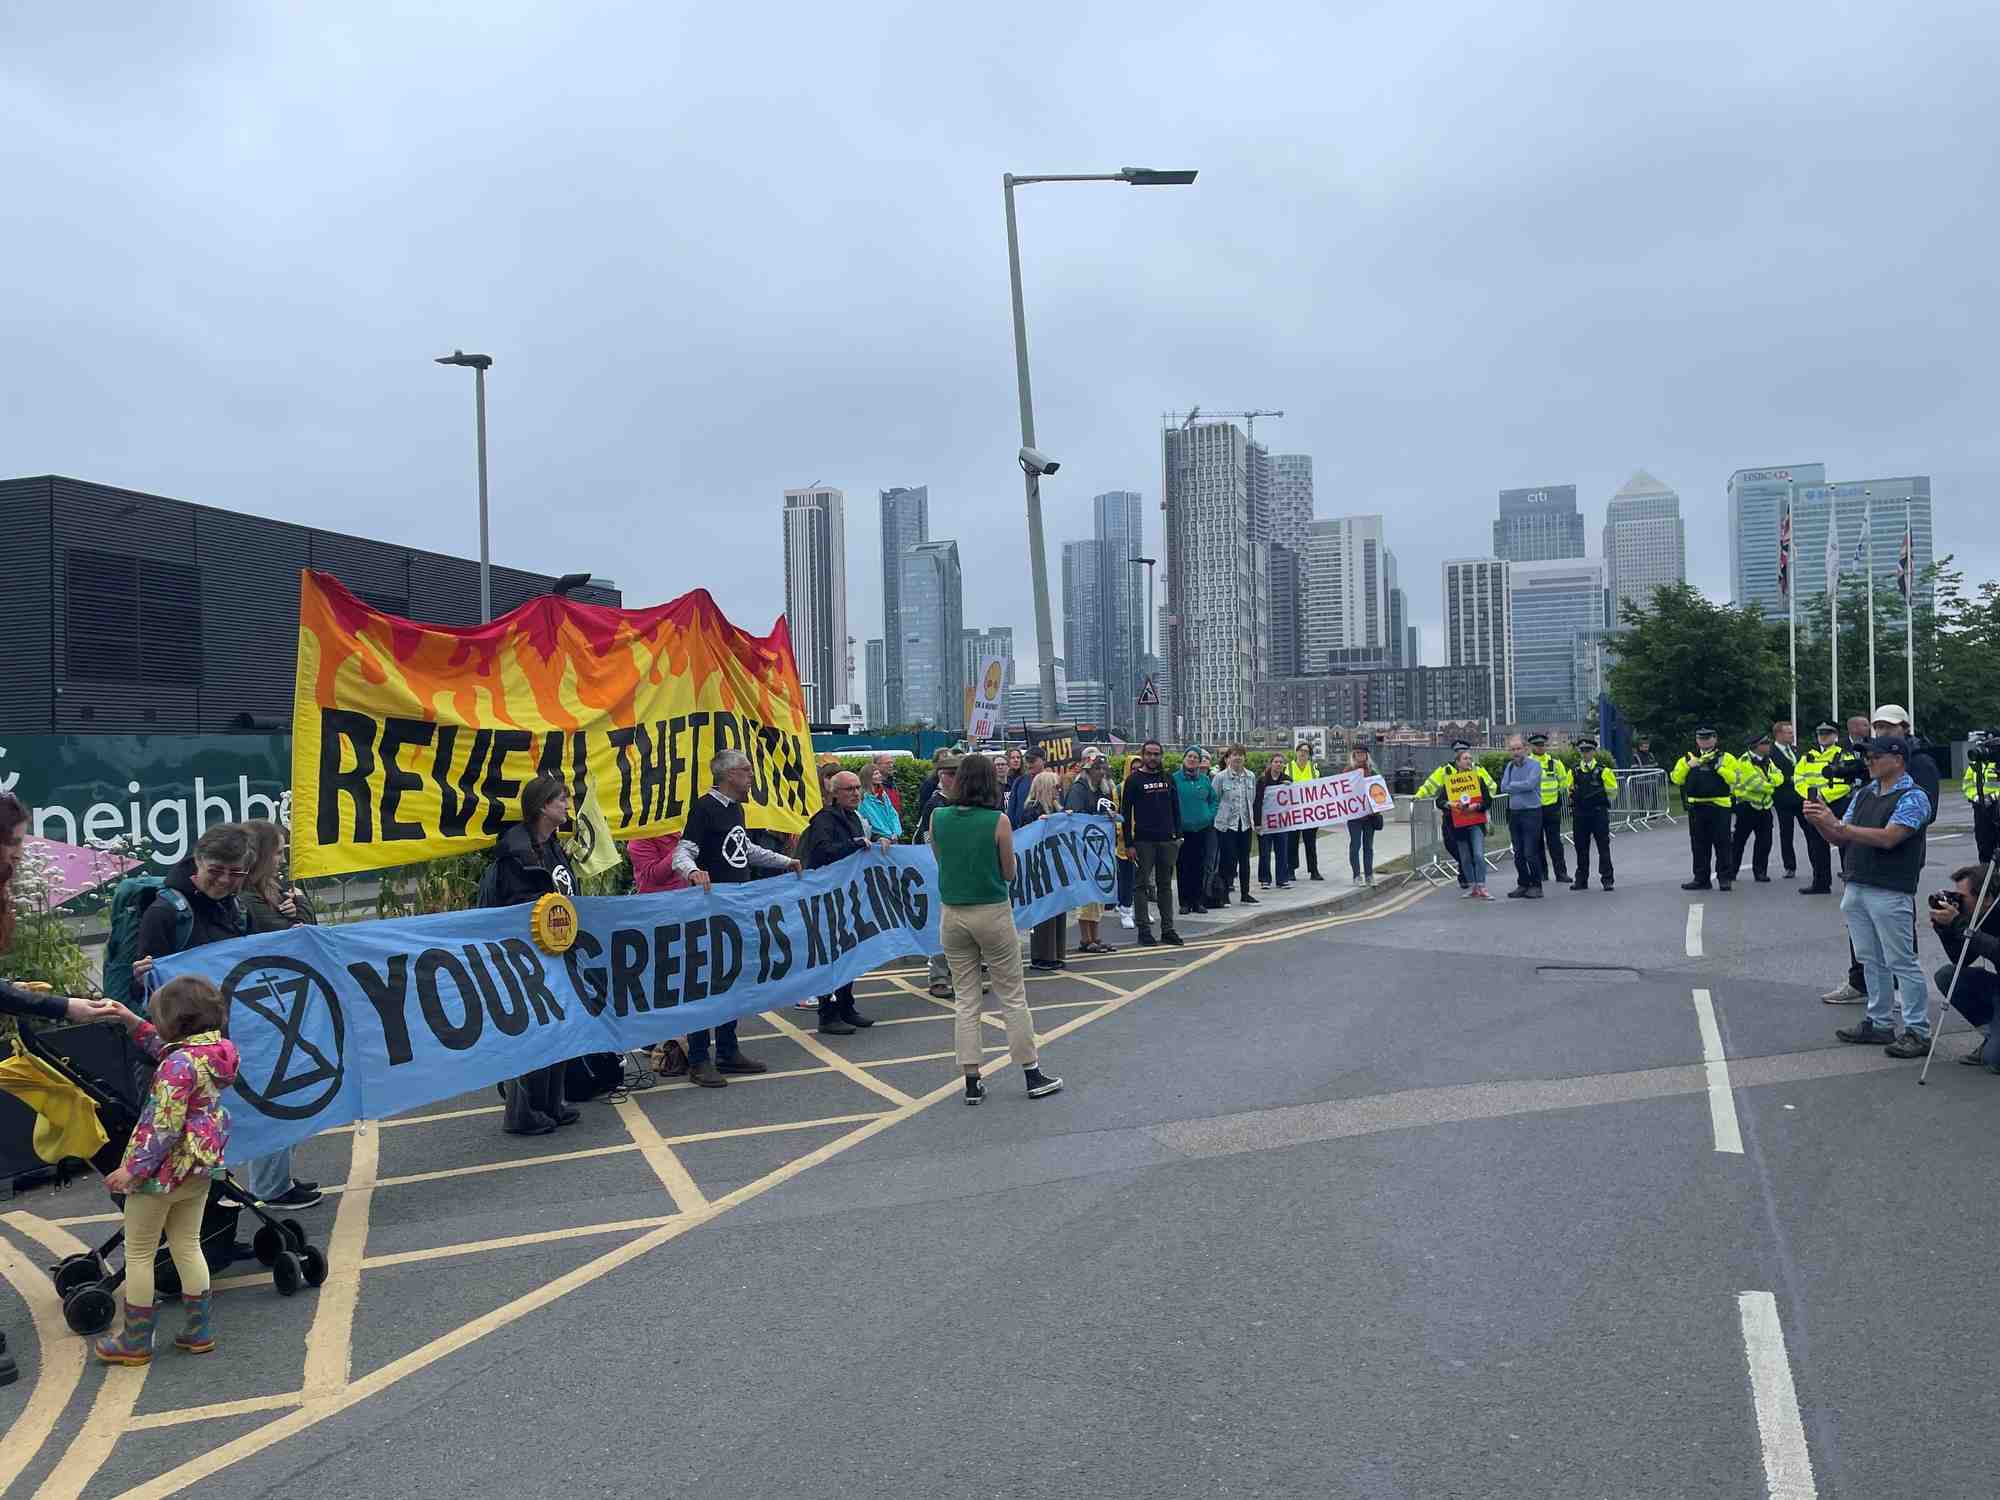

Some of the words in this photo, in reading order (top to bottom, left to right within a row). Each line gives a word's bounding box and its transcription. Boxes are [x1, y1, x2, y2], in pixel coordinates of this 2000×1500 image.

[1527, 491, 1548, 504] citi
[607, 715, 686, 829] THE
[1276, 780, 1353, 806] CLIMATE
[33, 774, 292, 865] neighb
[1266, 794, 1367, 828] EMERGENCY
[347, 938, 565, 1066] YOUR
[564, 914, 743, 1017] GREED
[756, 905, 792, 984] IS
[799, 865, 929, 968] KILLING
[1009, 831, 1087, 908] ANITY
